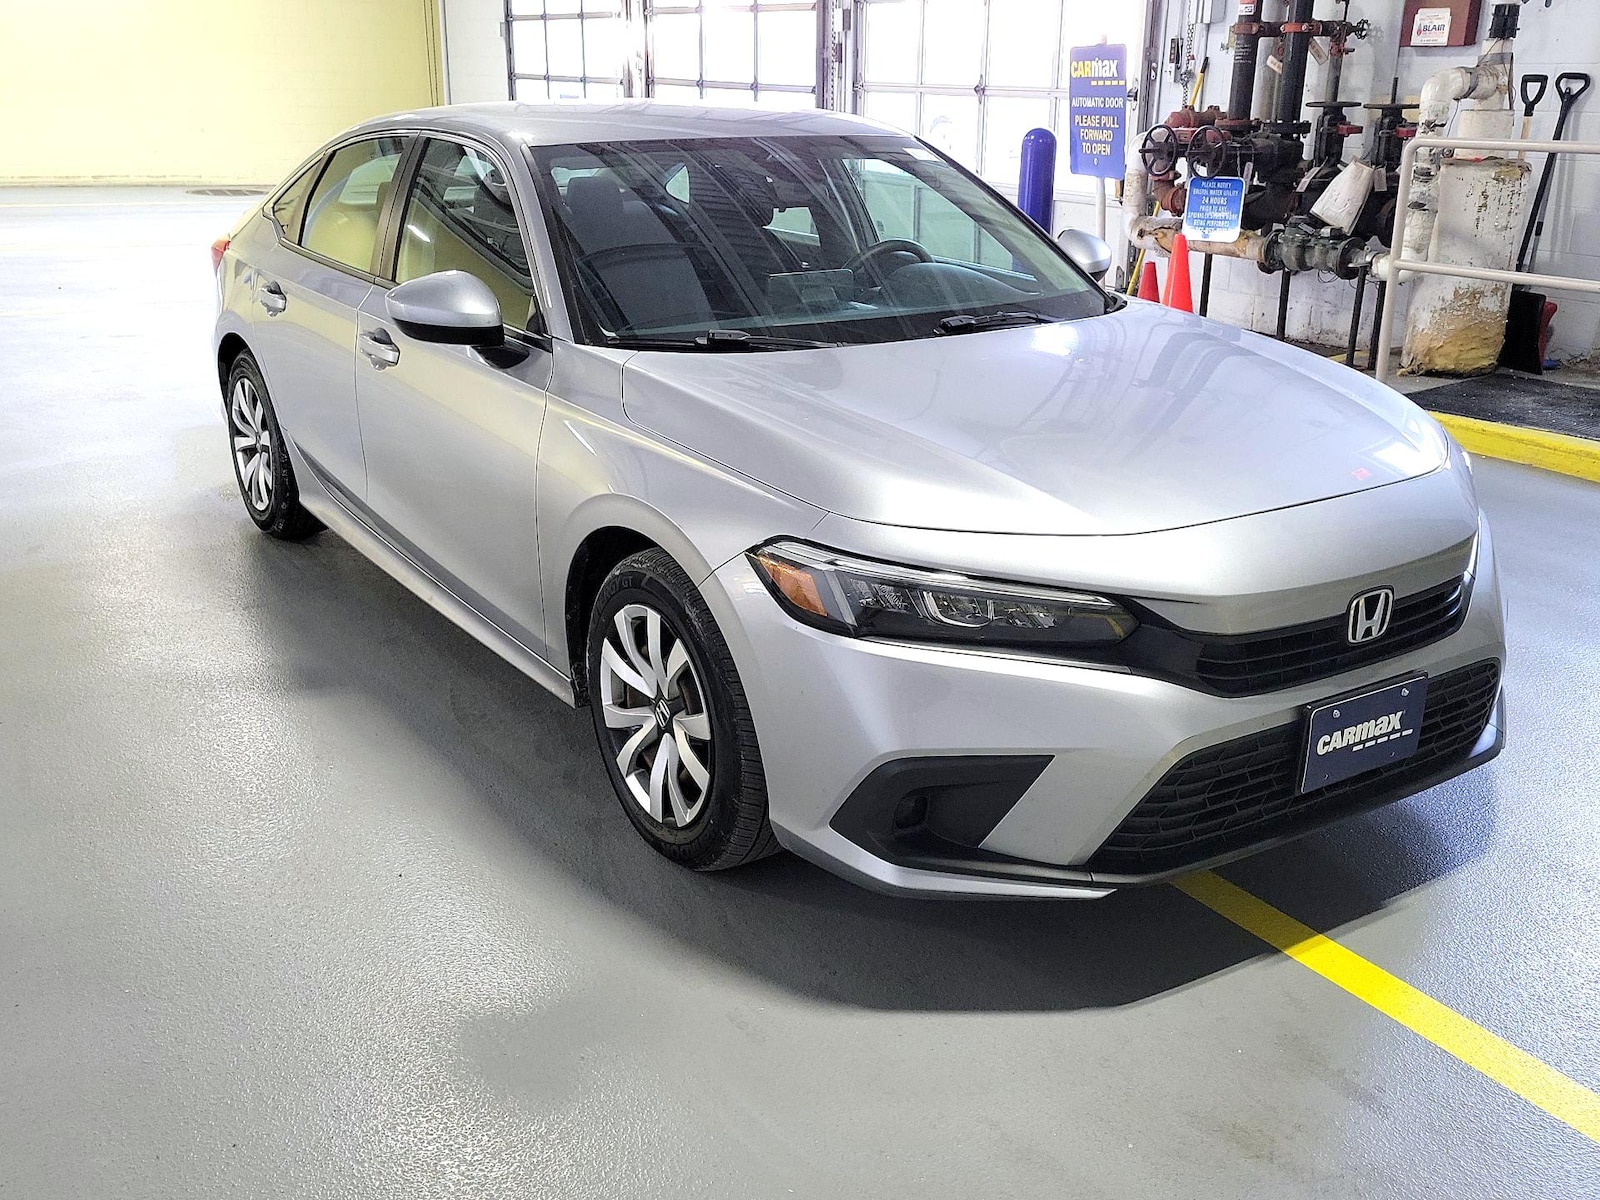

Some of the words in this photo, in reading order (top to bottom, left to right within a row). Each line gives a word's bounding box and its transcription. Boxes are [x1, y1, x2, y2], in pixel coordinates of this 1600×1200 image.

[1422, 24, 1446, 32] BLAIR
[1071, 58, 1118, 78] CARmax
[1072, 97, 1104, 107] AUTOMATIC
[1106, 97, 1124, 108] DOOR
[1075, 115, 1100, 127] PLEASE
[1101, 116, 1119, 128] PULL
[1080, 129, 1113, 142] FORWARD
[1082, 143, 1091, 154] TO
[1092, 143, 1111, 155] OPEN
[1210, 197, 1227, 205] HOURS
[1316, 711, 1404, 756] CARmax
